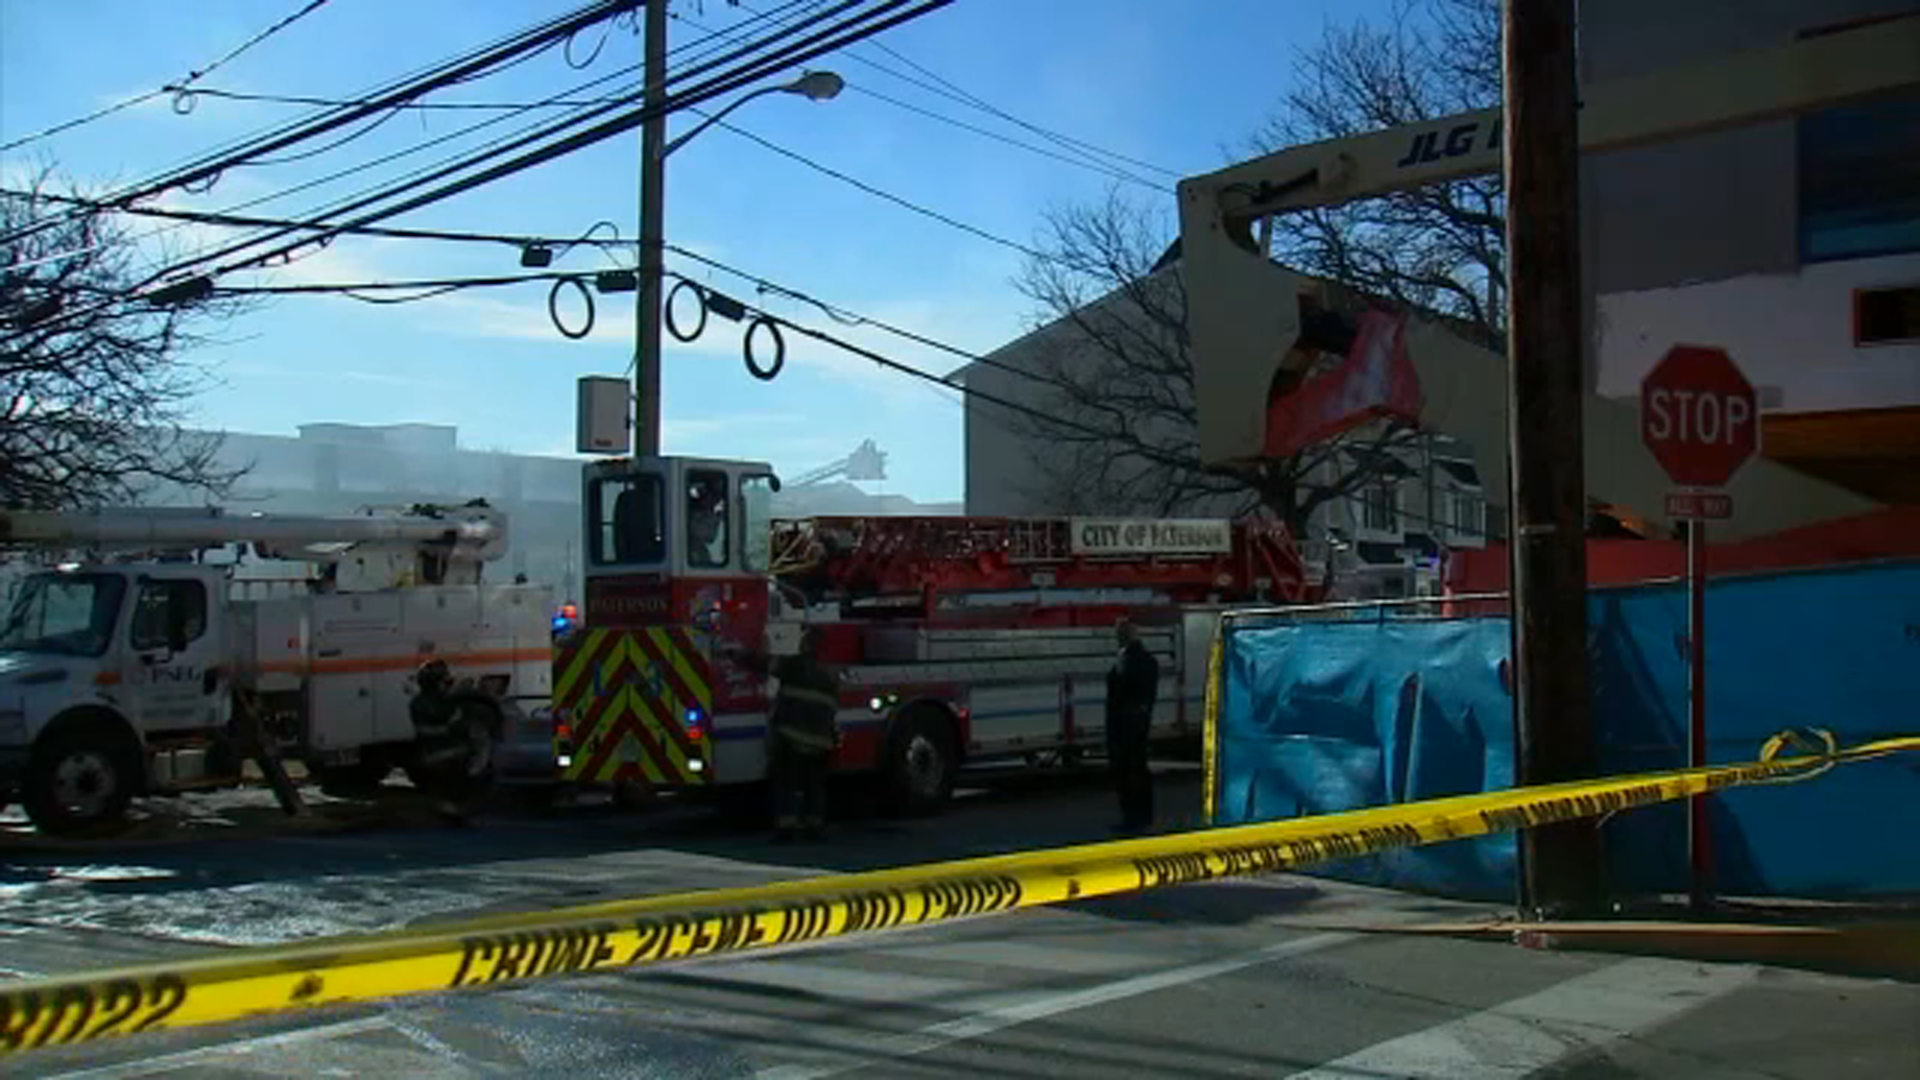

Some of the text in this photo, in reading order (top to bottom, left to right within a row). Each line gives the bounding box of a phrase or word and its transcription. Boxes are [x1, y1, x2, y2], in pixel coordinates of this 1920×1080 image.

[1397, 122, 1479, 168] JLG
[1648, 388, 1750, 445] STOP
[1082, 524, 1223, 547] CITY OF PATERSON
